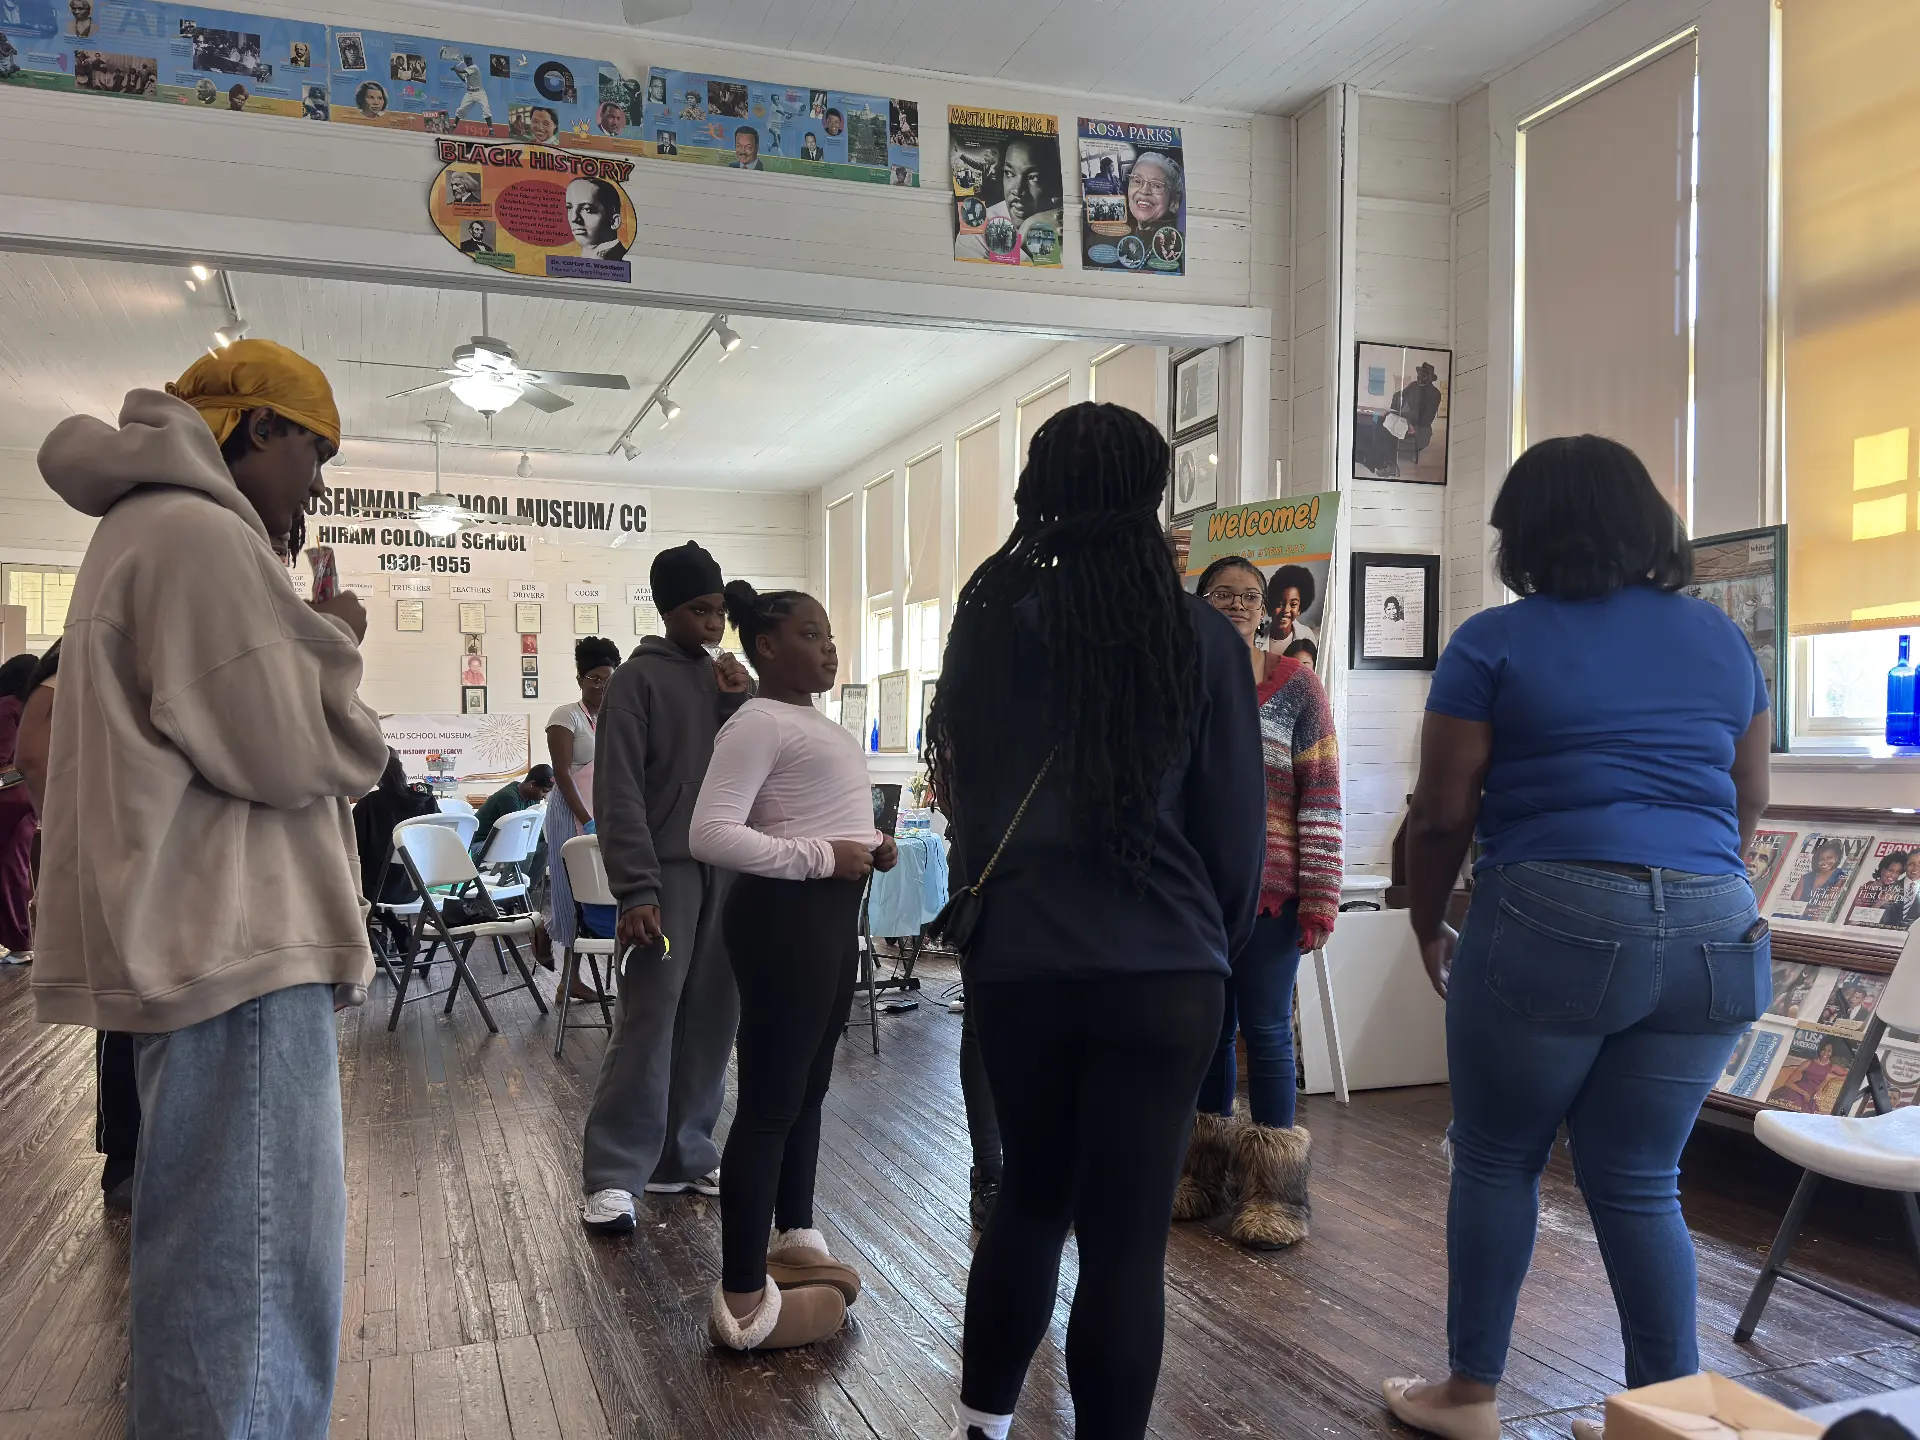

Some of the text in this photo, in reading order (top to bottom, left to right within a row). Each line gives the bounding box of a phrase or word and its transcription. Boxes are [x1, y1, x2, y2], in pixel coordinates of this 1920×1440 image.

[465, 125, 490, 136] 1947
[1088, 121, 1172, 143] ROSA PARKS
[440, 140, 634, 181] BLACK HISTORY
[594, 263, 625, 271] Woodson
[304, 487, 423, 520] OSENWALD
[620, 504, 647, 532] CC
[1208, 496, 1320, 542] Welcome!
[318, 525, 376, 545] HIRAM
[462, 532, 526, 552] SCHOOL
[1258, 547, 1283, 557] STEM
[1286, 544, 1307, 554] DAY
[378, 553, 471, 574] 1930-1955
[391, 584, 431, 592] TRUSTEES
[451, 586, 491, 594] TEACHERS
[513, 591, 545, 599] DRIVERS
[406, 732, 437, 740] SCHOOL
[1876, 843, 1919, 857] EBON
[1805, 1031, 1823, 1044] USA
[1793, 1039, 1819, 1051] WEEKEN
